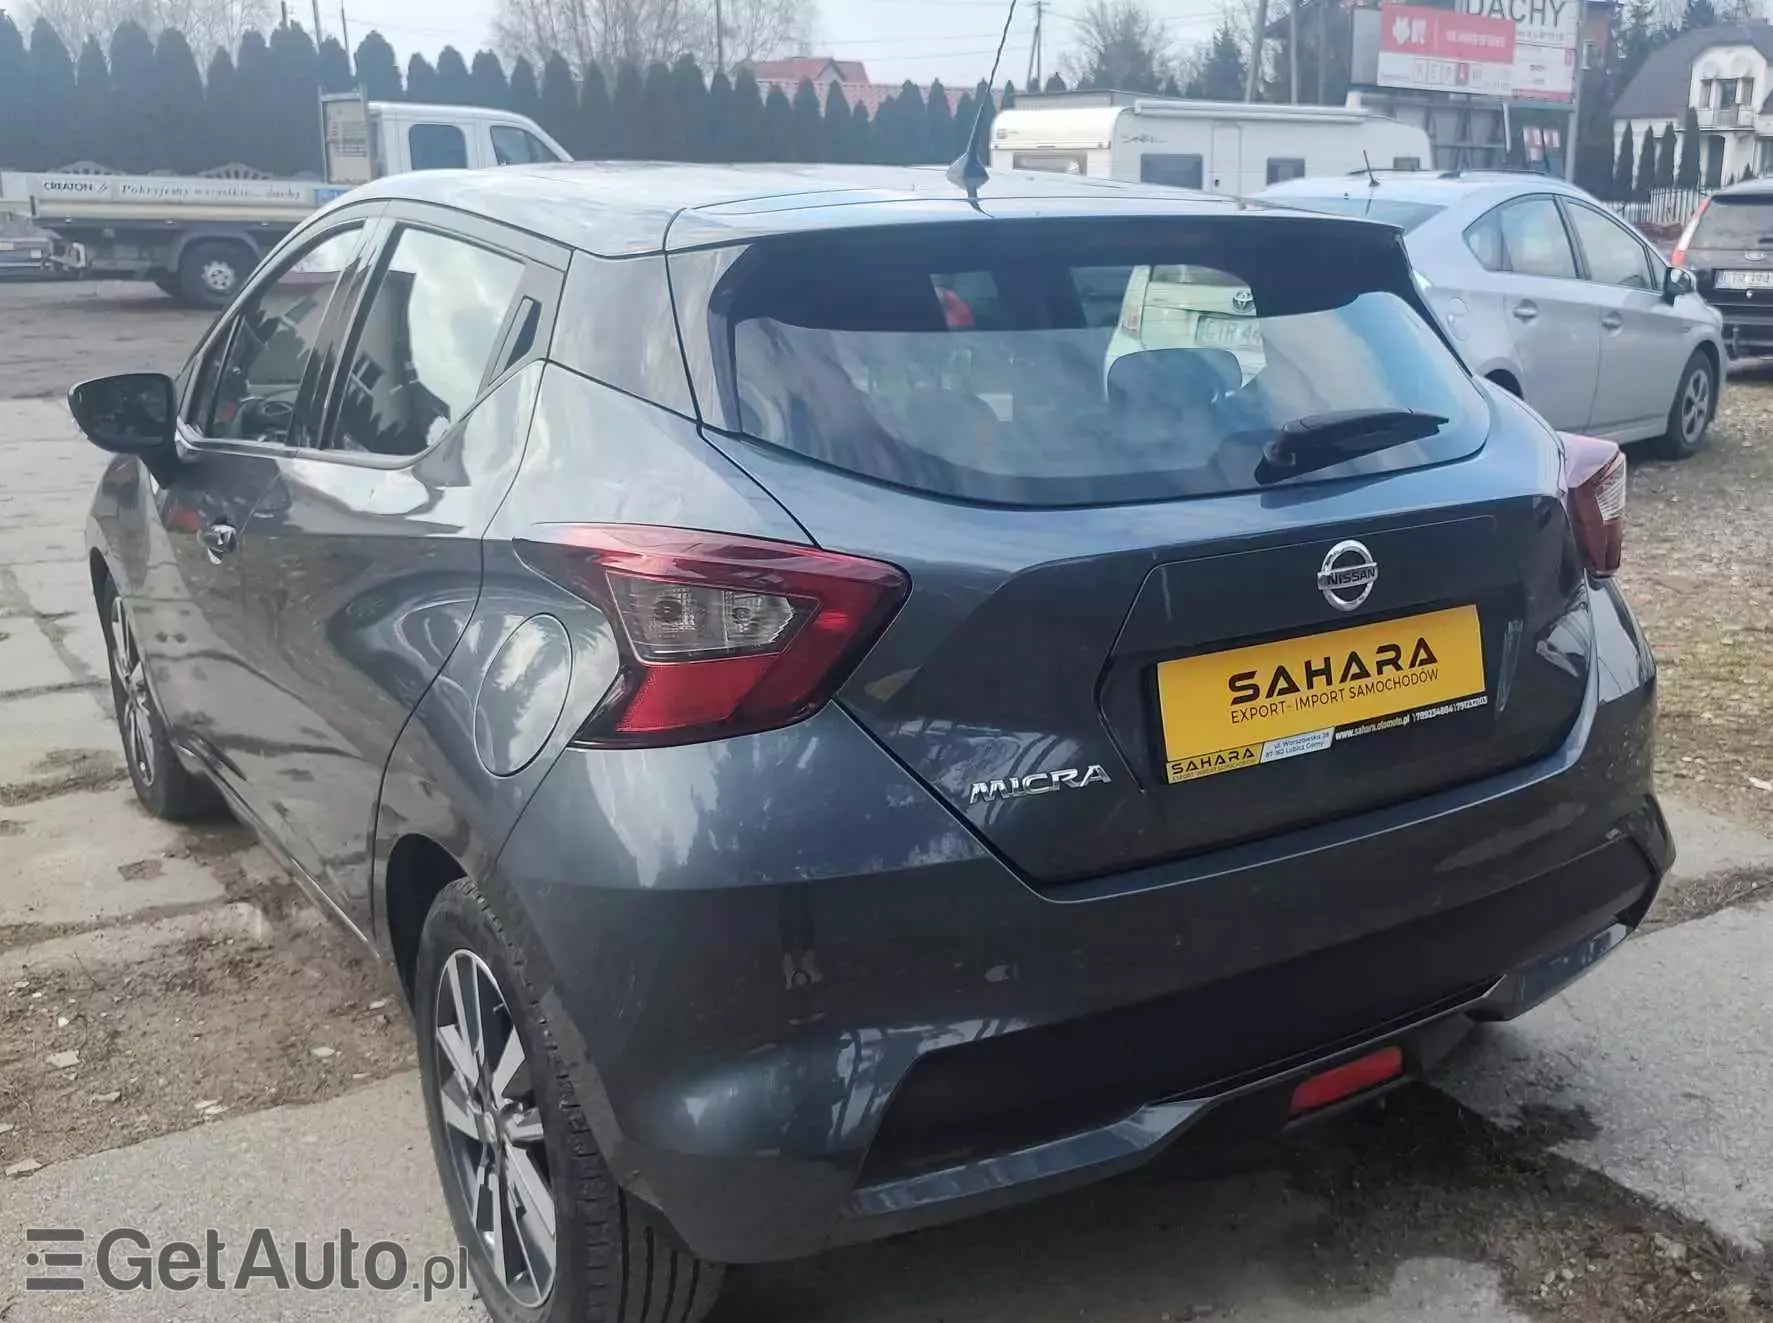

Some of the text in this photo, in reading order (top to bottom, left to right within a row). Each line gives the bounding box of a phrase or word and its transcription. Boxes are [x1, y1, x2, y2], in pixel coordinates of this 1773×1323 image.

[1328, 566, 1375, 585] NISSAN
[1228, 637, 1438, 706] SAHARA
[1295, 687, 1345, 710] IMPORT
[1349, 667, 1439, 699] SAMOCHODÓW
[1171, 747, 1256, 775] SAHARA
[969, 764, 1112, 804] MICRA
